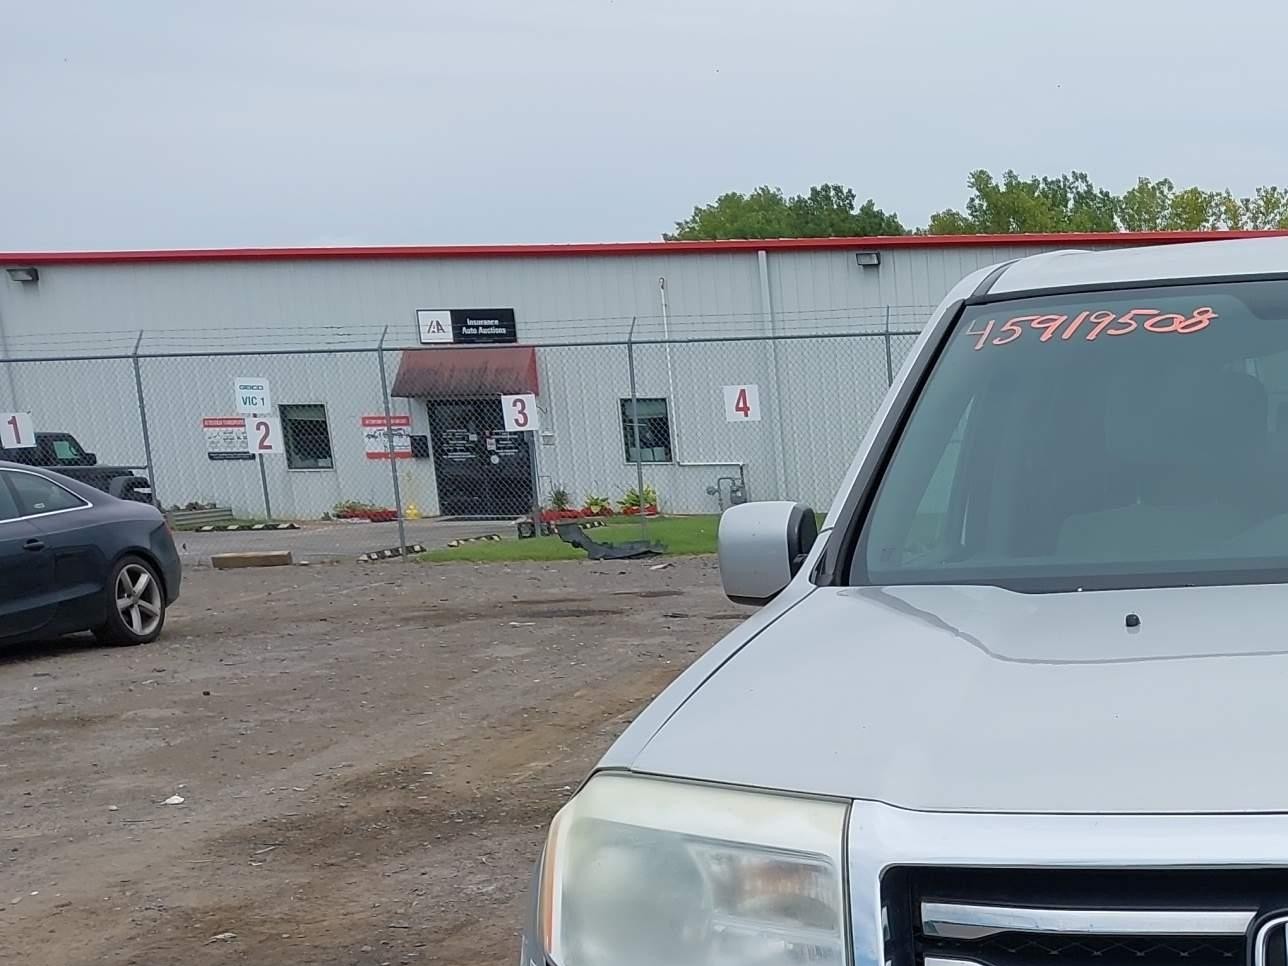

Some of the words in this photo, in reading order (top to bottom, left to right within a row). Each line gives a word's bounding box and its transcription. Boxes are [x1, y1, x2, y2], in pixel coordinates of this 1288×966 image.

[479, 326, 506, 334] Auctions
[966, 307, 1219, 350] 45919508
[242, 396, 257, 406] VIC
[260, 397, 265, 406] 1
[512, 399, 529, 428] 3
[735, 389, 750, 417] 4
[8, 416, 21, 444] 1
[255, 421, 273, 450] 2
